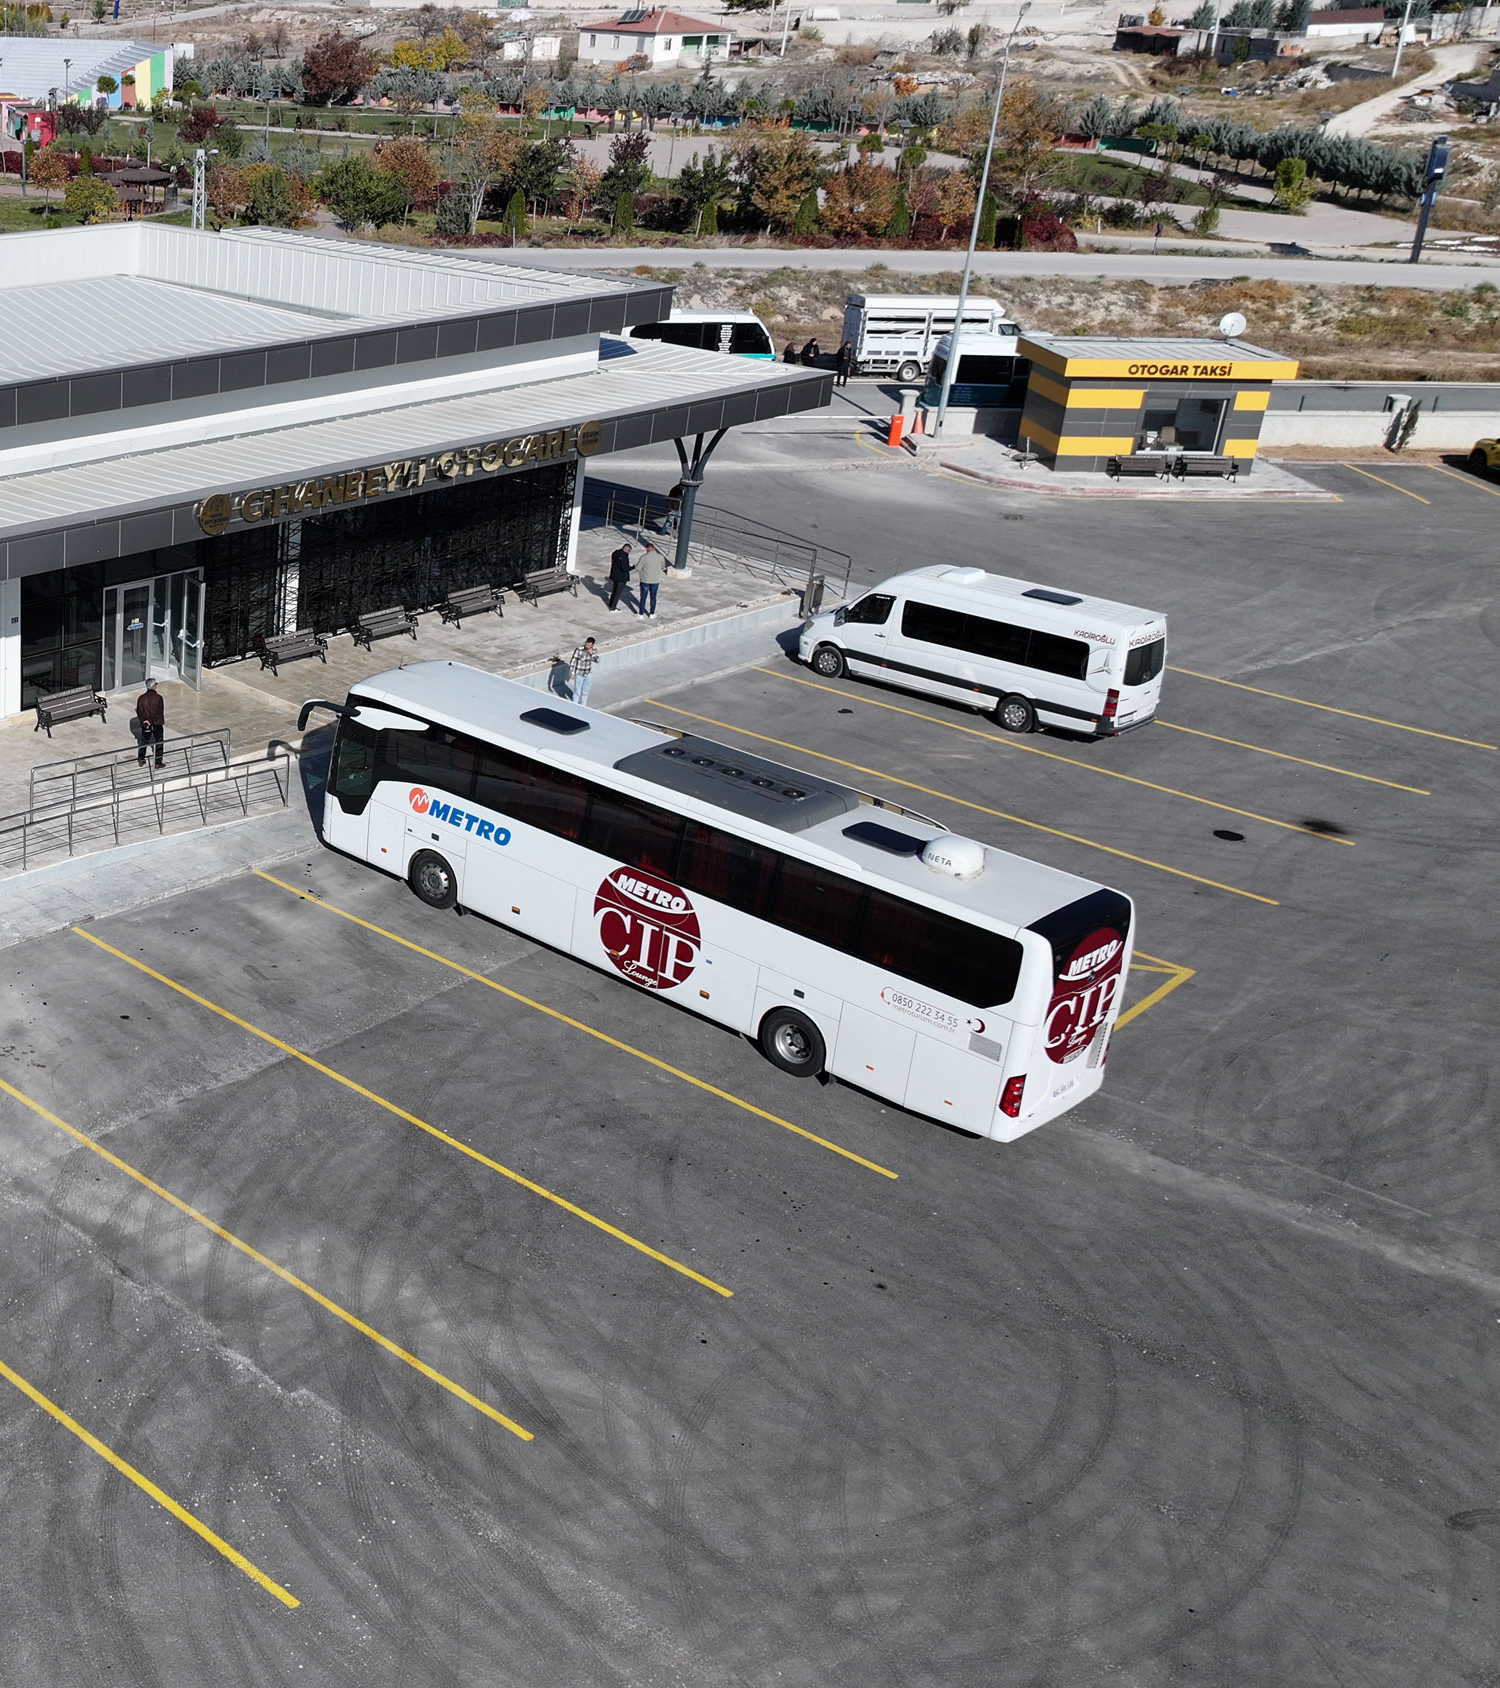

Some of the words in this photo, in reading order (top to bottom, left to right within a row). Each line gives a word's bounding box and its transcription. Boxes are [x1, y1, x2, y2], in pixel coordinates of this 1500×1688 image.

[1128, 364, 1189, 376] OTOGAR
[1192, 362, 1233, 376] TAKSİ
[435, 428, 572, 482] OTOGARI
[428, 799, 512, 846] METRO
[927, 852, 952, 868] NETA
[617, 873, 687, 912] METRO
[593, 906, 700, 984] CIP
[1067, 939, 1119, 977] METRO
[891, 1003, 956, 1034] metroturizm.com.tr
[892, 993, 914, 1009] 0850
[915, 1003, 933, 1017] 222
[935, 1010, 946, 1022] 34
[947, 1017, 959, 1028] 55
[1044, 973, 1120, 1049] CIP
